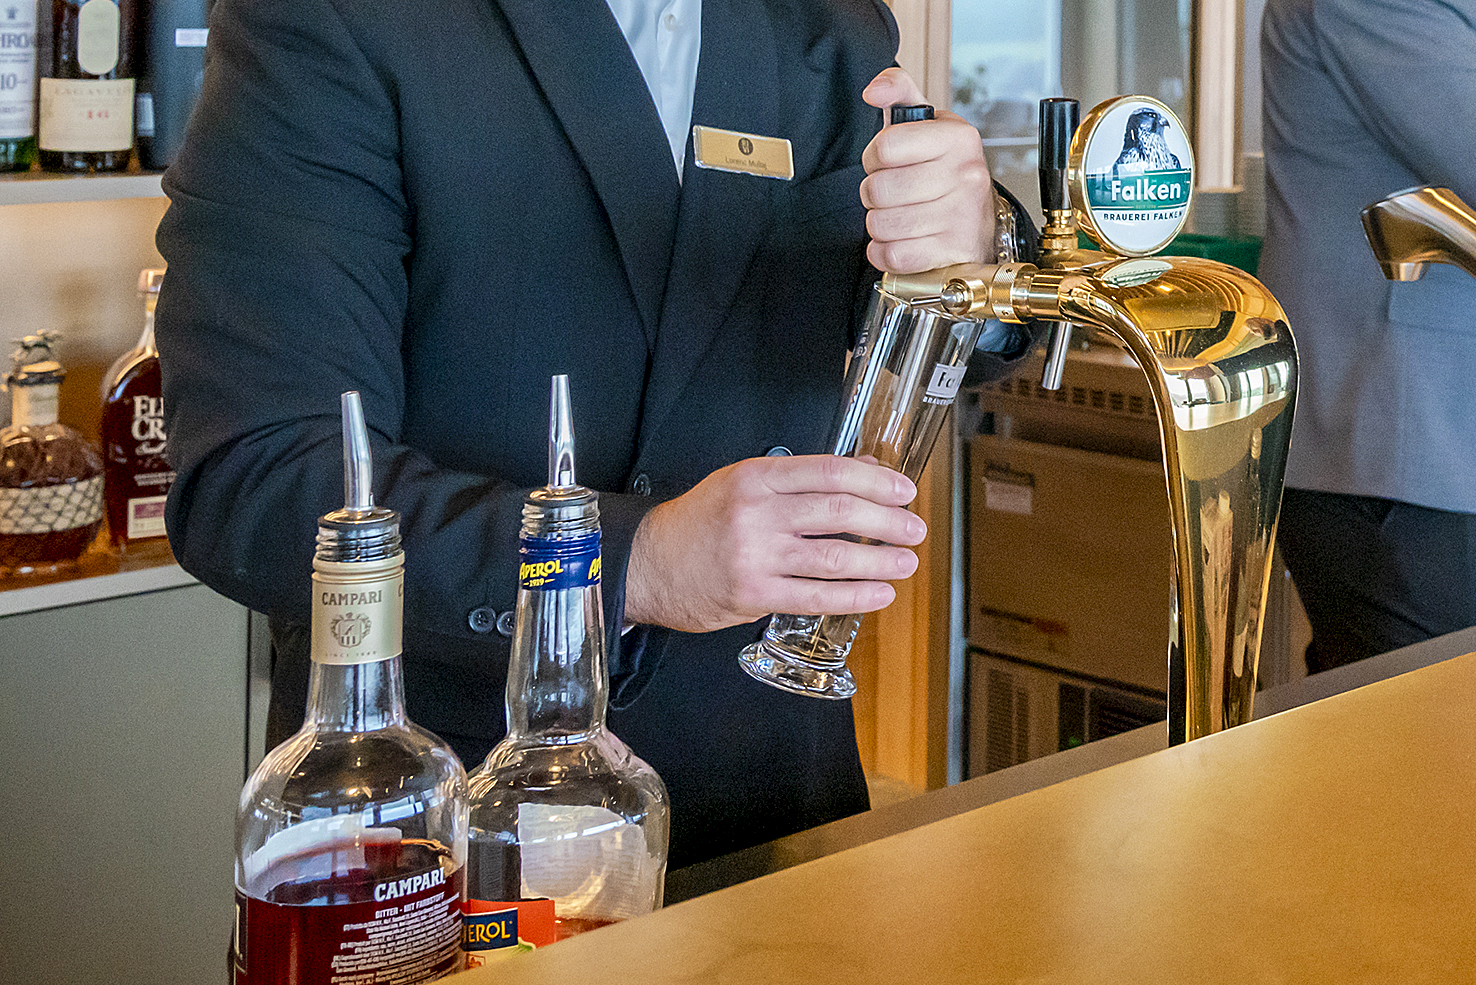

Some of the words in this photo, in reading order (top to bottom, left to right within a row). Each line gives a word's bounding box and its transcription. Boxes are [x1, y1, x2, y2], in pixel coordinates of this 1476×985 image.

[1111, 178, 1181, 201] Falken
[1103, 213, 1150, 221] BRAUEREI
[1153, 211, 1182, 220] FALKEN
[519, 559, 564, 580] APEROL
[321, 590, 383, 606] CAMPARI
[374, 866, 446, 902] CAMPARI
